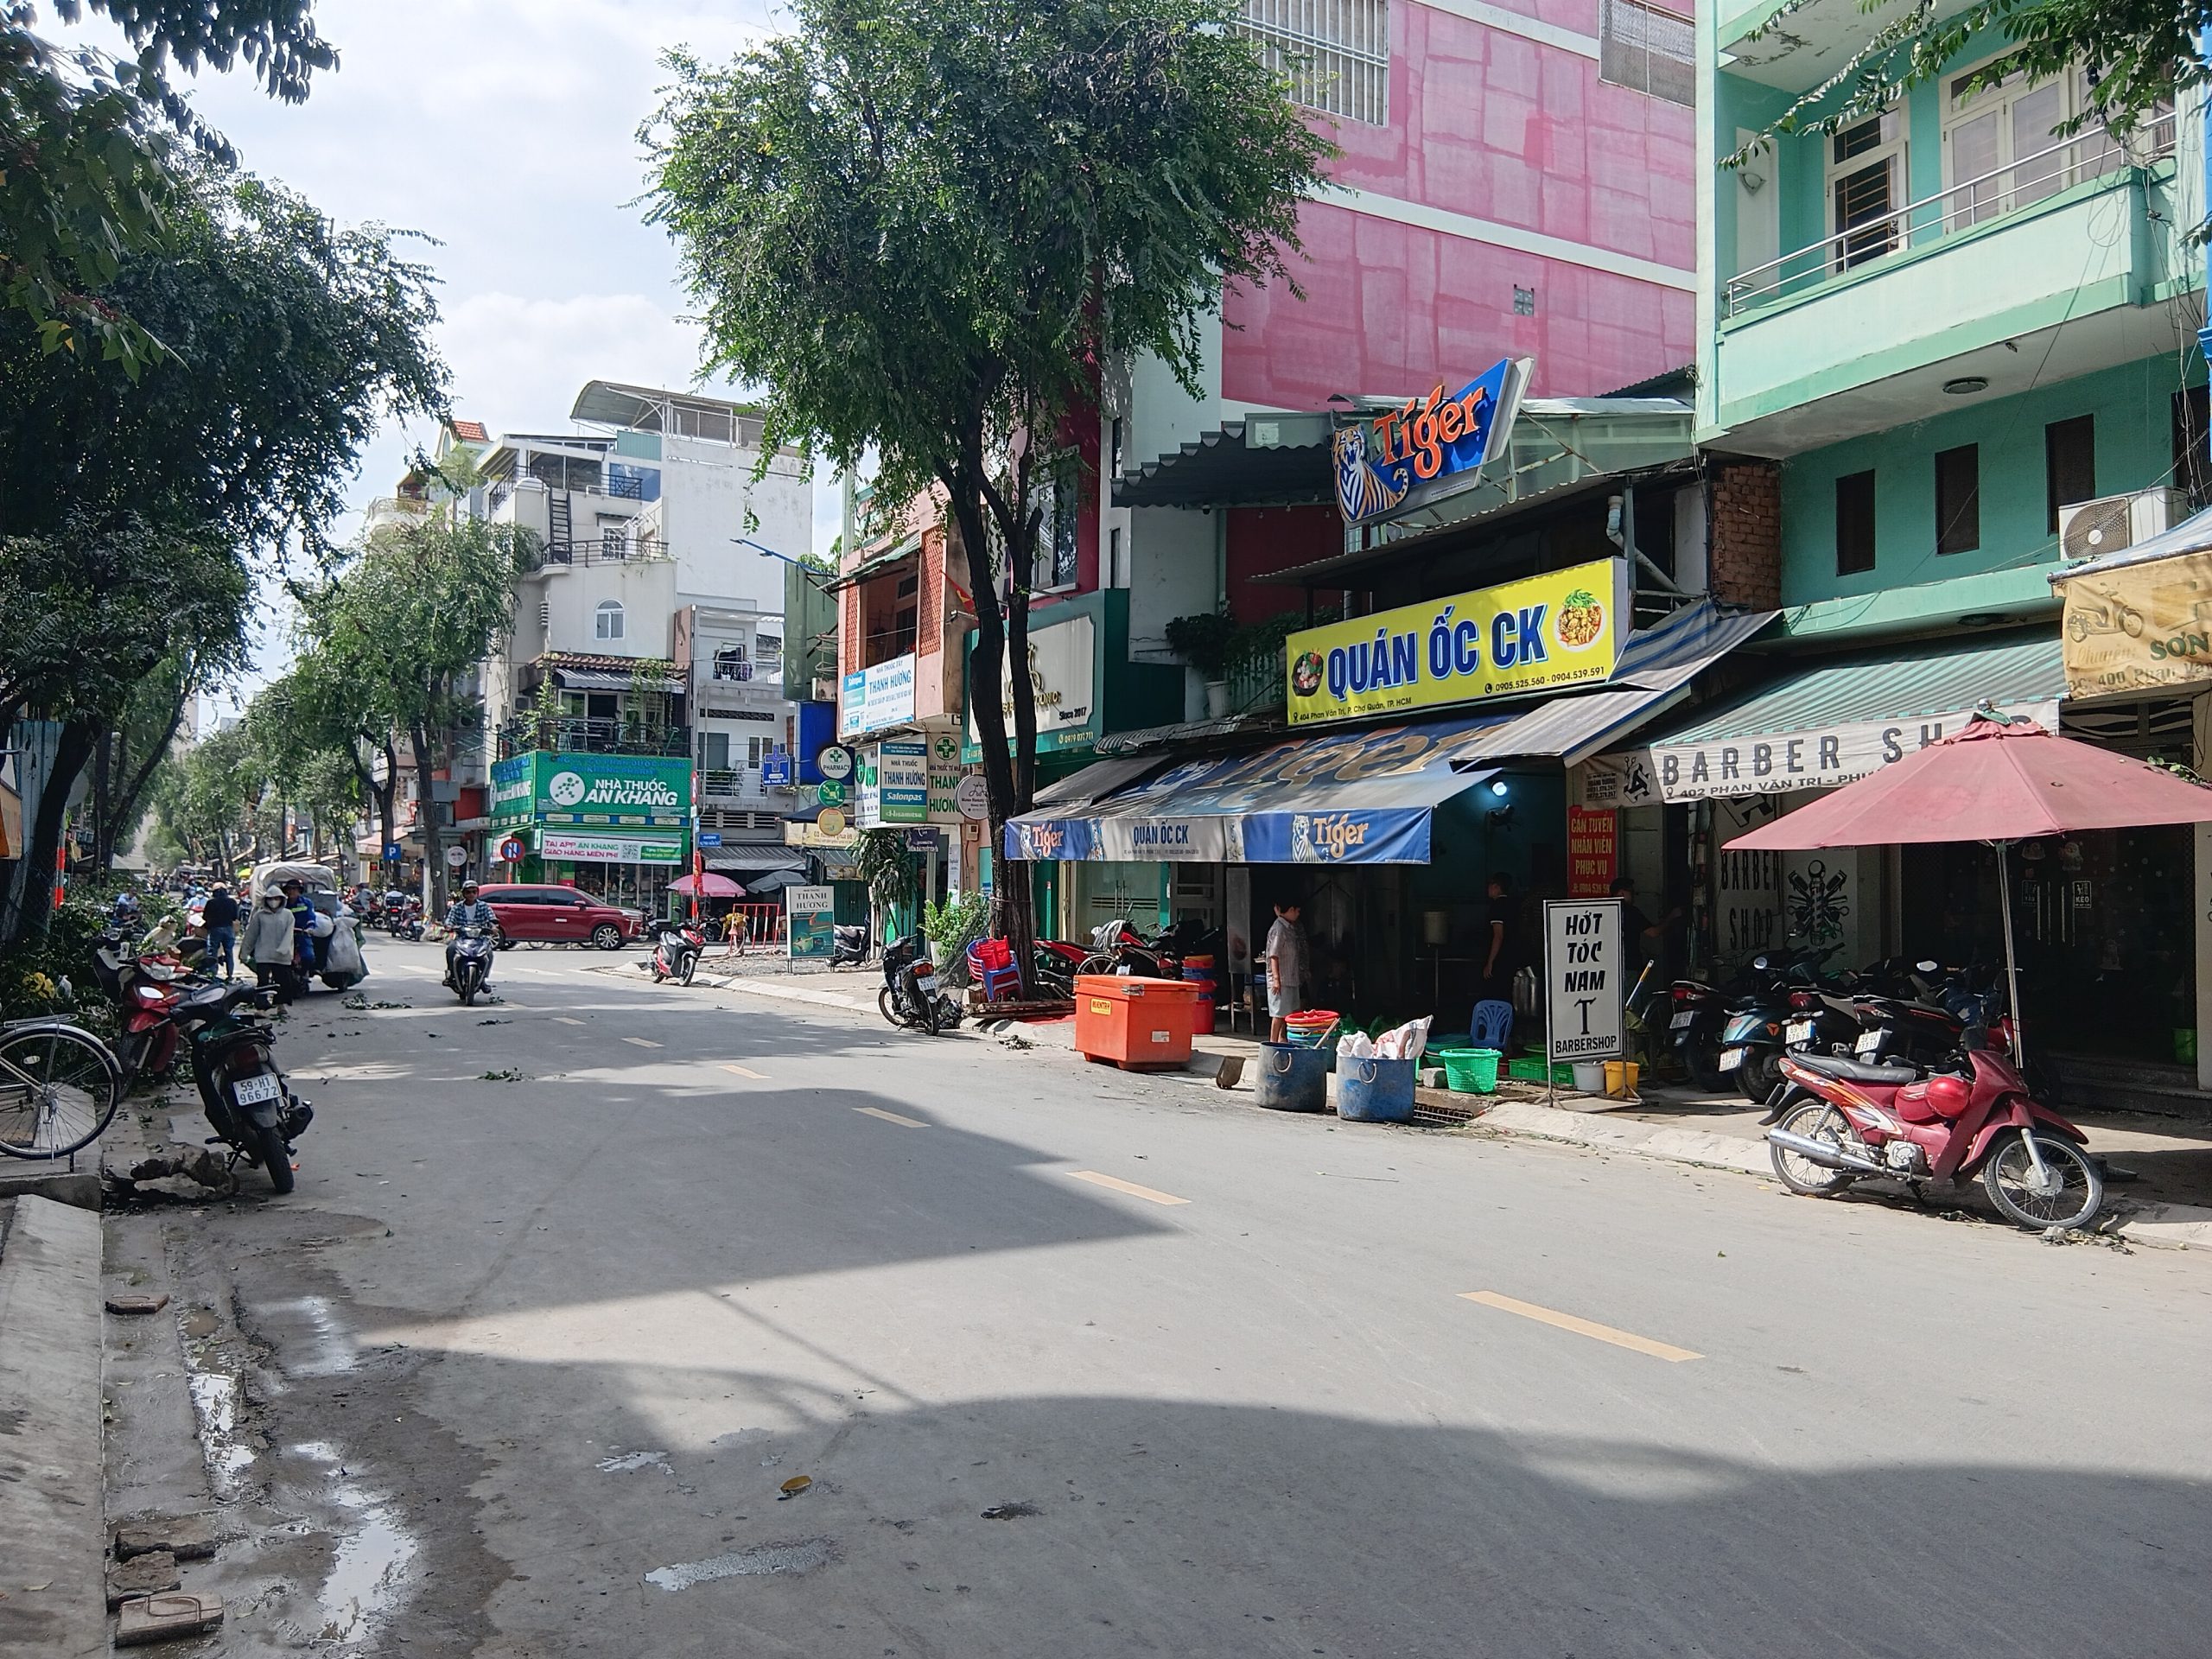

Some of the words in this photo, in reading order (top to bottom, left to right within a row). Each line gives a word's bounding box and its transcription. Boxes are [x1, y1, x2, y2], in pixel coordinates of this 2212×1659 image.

[1374, 384, 1485, 479] Tiger
[1326, 626, 1419, 702] QUÁN
[1427, 604, 1479, 679] ỐC
[1491, 603, 1548, 669] CK
[2150, 631, 2209, 661] SƠN
[869, 677, 889, 695] THANH
[1495, 676, 1545, 692] 0905.525.560
[1551, 666, 1605, 683] 0904.539.591
[2098, 671, 2126, 686] 400
[1074, 707, 1087, 717] 2017
[1353, 704, 1366, 714] Chợ
[1387, 700, 1395, 709] TP.
[1396, 697, 1412, 707] HCM
[1662, 734, 1840, 786] BARBER
[595, 778, 622, 790] NHÀ
[624, 779, 667, 791] THUỐC
[884, 771, 904, 785] THANH
[906, 770, 925, 786] HƯƠNG
[1710, 784, 1752, 795] PHAN
[1757, 777, 1792, 791] VĂN
[584, 789, 613, 804] AN
[613, 790, 678, 806] KHANG
[887, 791, 923, 803] Salonpas
[1032, 823, 1065, 857] Tiger
[1134, 822, 1159, 847] QUÁN
[1175, 824, 1189, 844] CK
[1313, 812, 1370, 858] Tiger
[389, 848, 397, 856] P
[1571, 835, 1592, 854] NHÂN
[1575, 859, 1595, 878] PHỤC
[1597, 859, 1608, 878] VỤ
[1566, 910, 1603, 936] HỚT
[1567, 938, 1602, 963] TÓC
[1565, 970, 1605, 993] NAM
[1555, 1035, 1617, 1053] BARBERSHOP
[239, 1085, 278, 1103] 966.72
